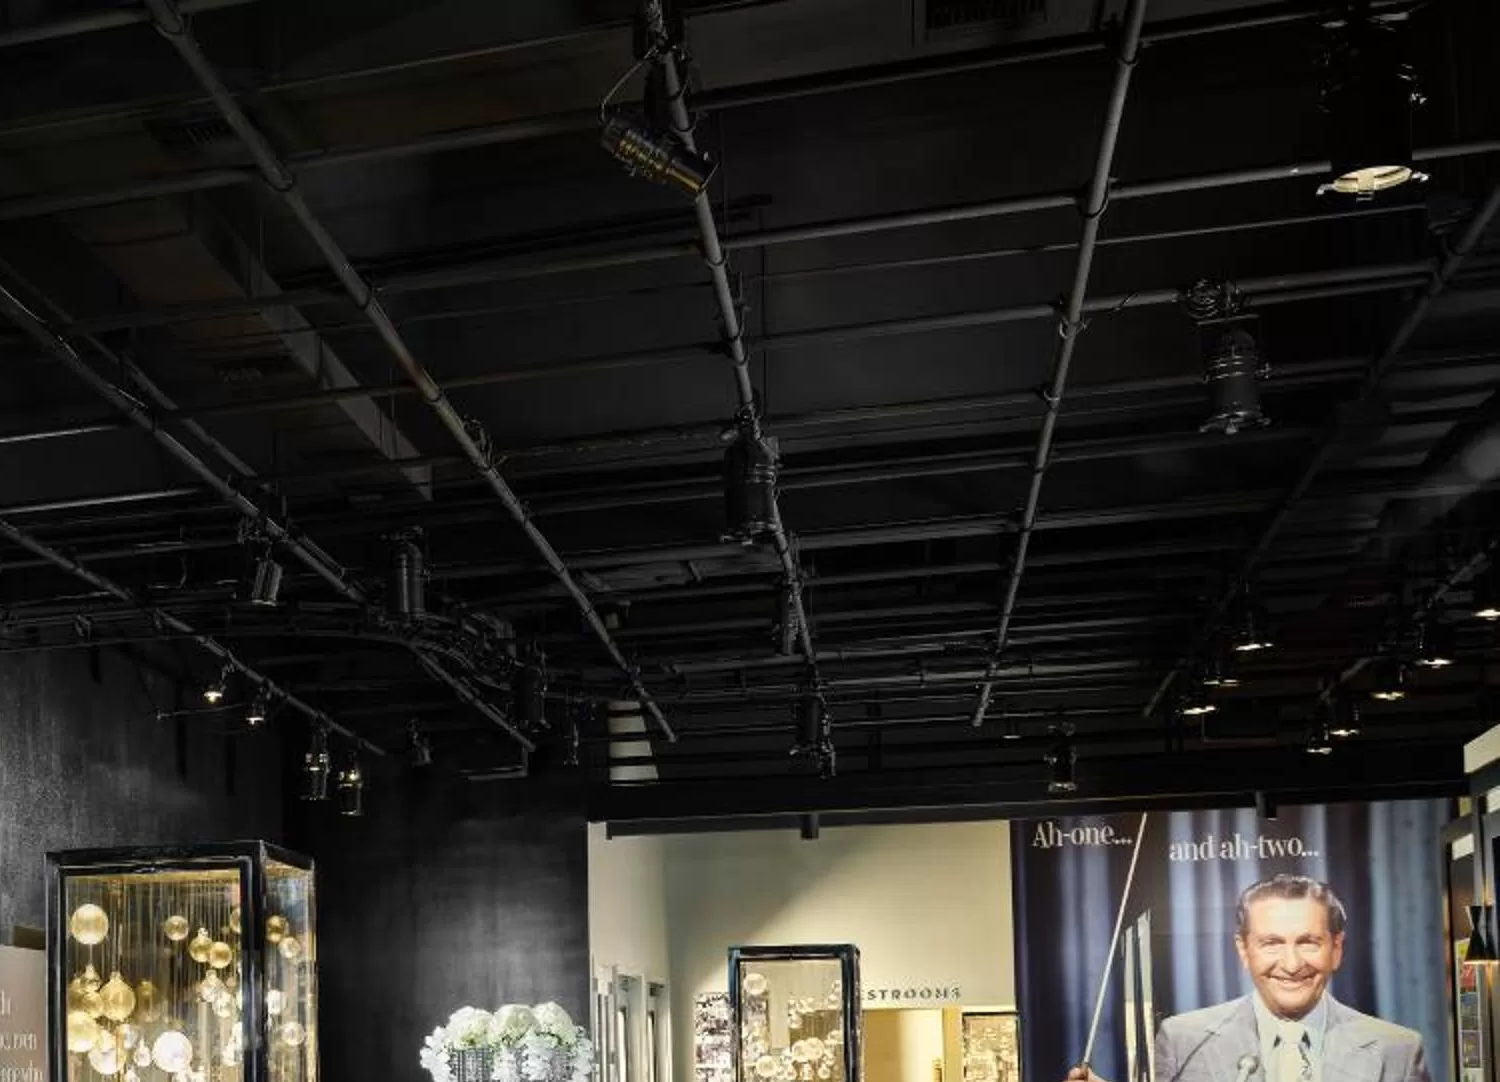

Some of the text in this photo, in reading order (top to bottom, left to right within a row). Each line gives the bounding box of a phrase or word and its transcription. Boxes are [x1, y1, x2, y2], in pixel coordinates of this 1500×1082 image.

[1032, 821, 1133, 849] Ah-one...
[1169, 832, 1320, 861] and ah-two...
[860, 987, 961, 1001] STROOMS
